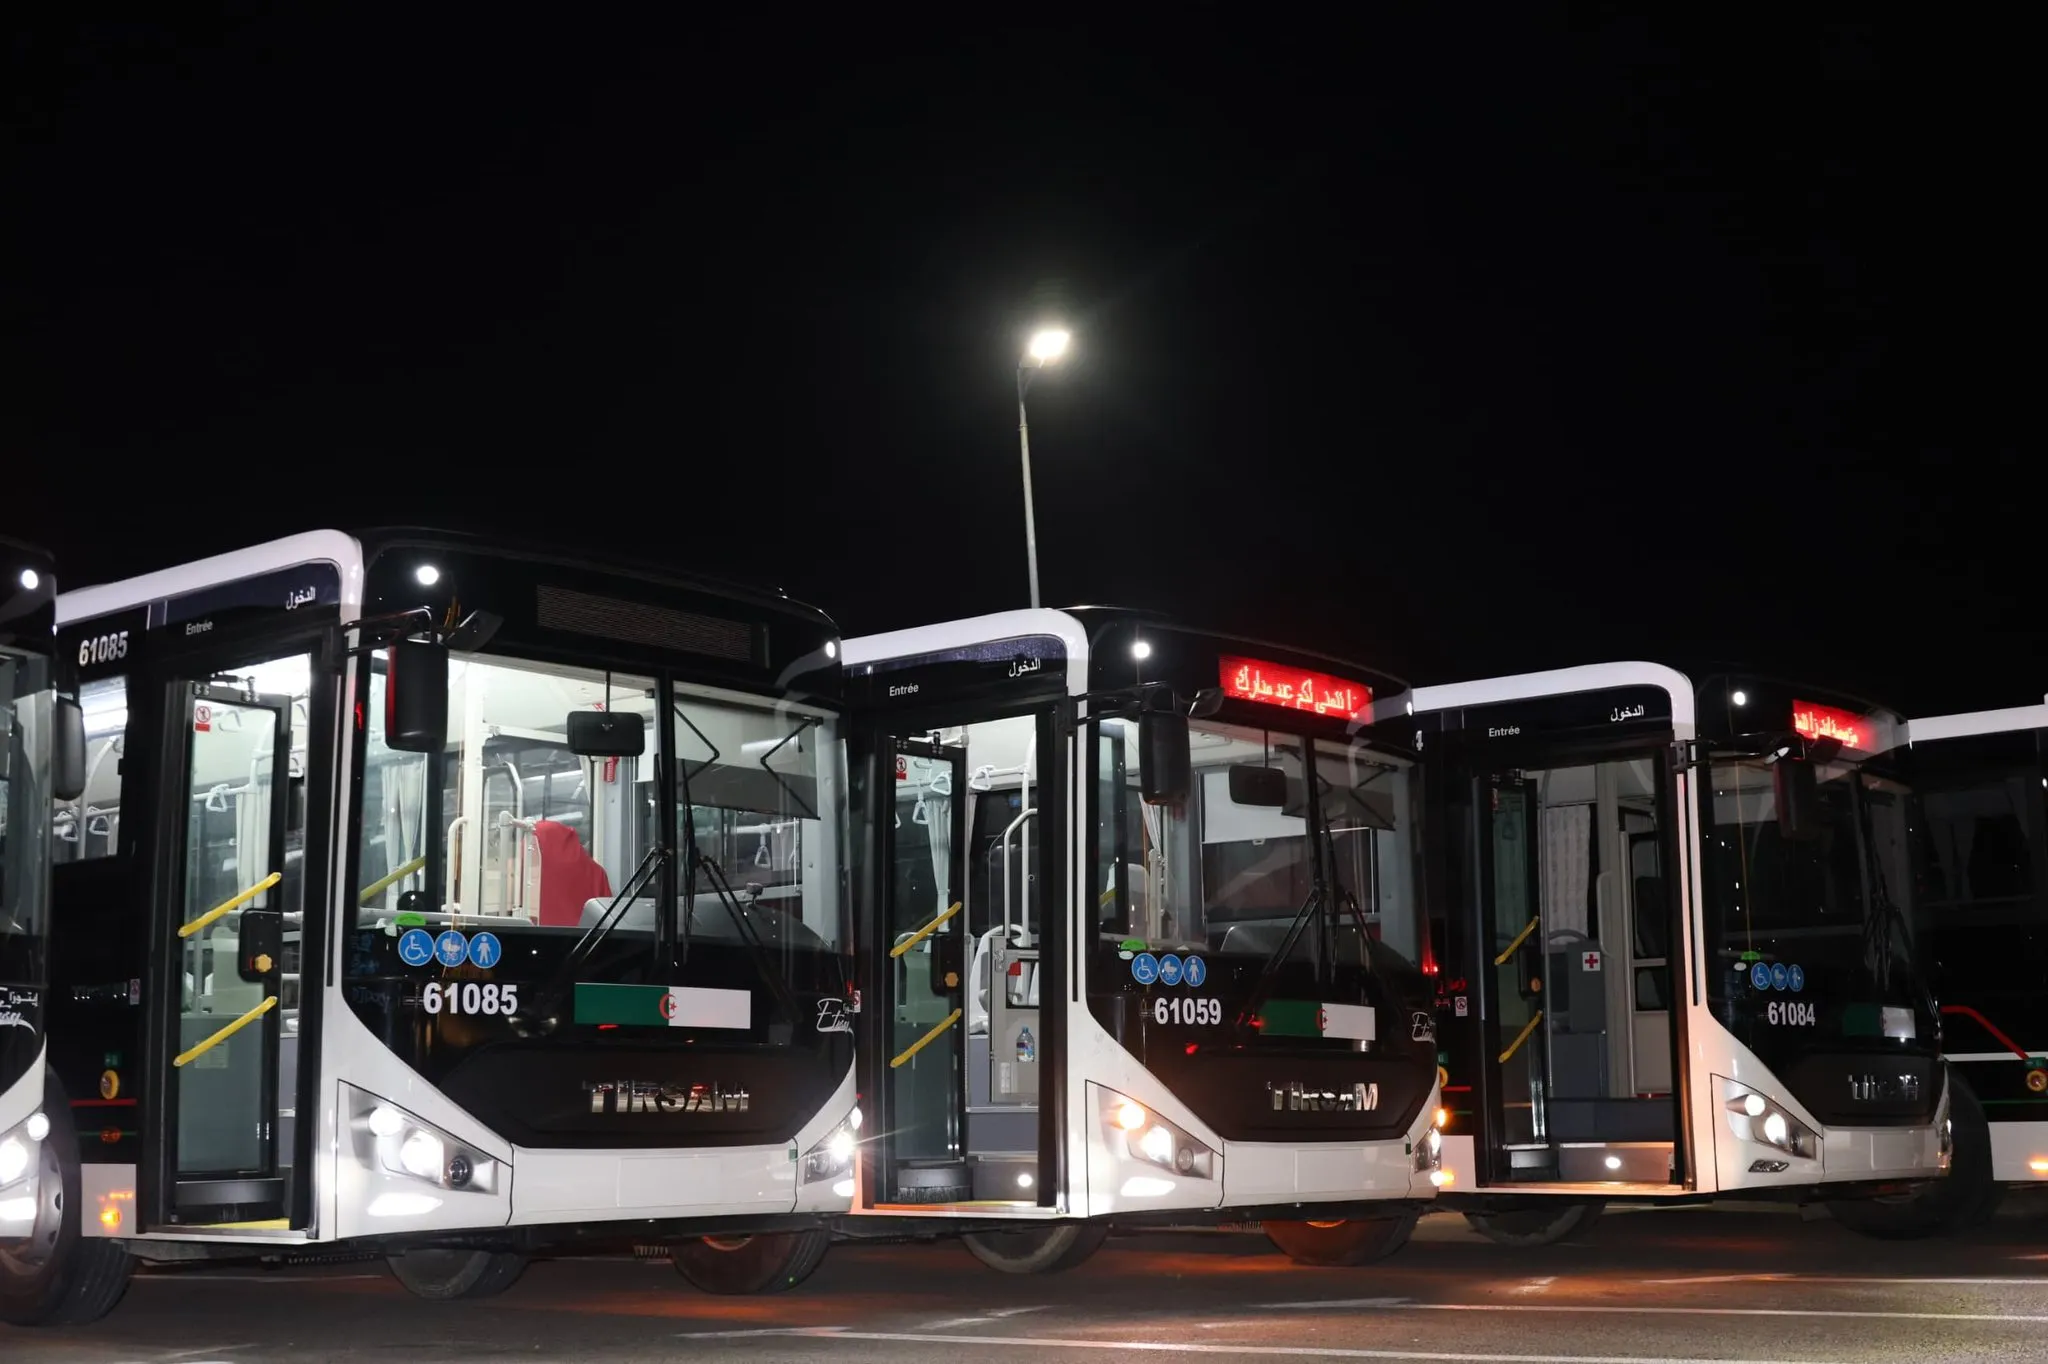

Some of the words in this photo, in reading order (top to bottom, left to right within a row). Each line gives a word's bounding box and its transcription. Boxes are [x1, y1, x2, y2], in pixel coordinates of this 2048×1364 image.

[285, 586, 316, 610] الدخول
[185, 619, 214, 635] Entrée
[79, 630, 129, 667] 61085
[1008, 657, 1041, 677] الدخول
[889, 683, 919, 697] Entrée
[1610, 704, 1644, 722] الدخول
[1488, 726, 1521, 737] Entrée
[423, 982, 518, 1015] 61085
[1154, 997, 1222, 1025] 61059
[1768, 1001, 1816, 1026] 61084
